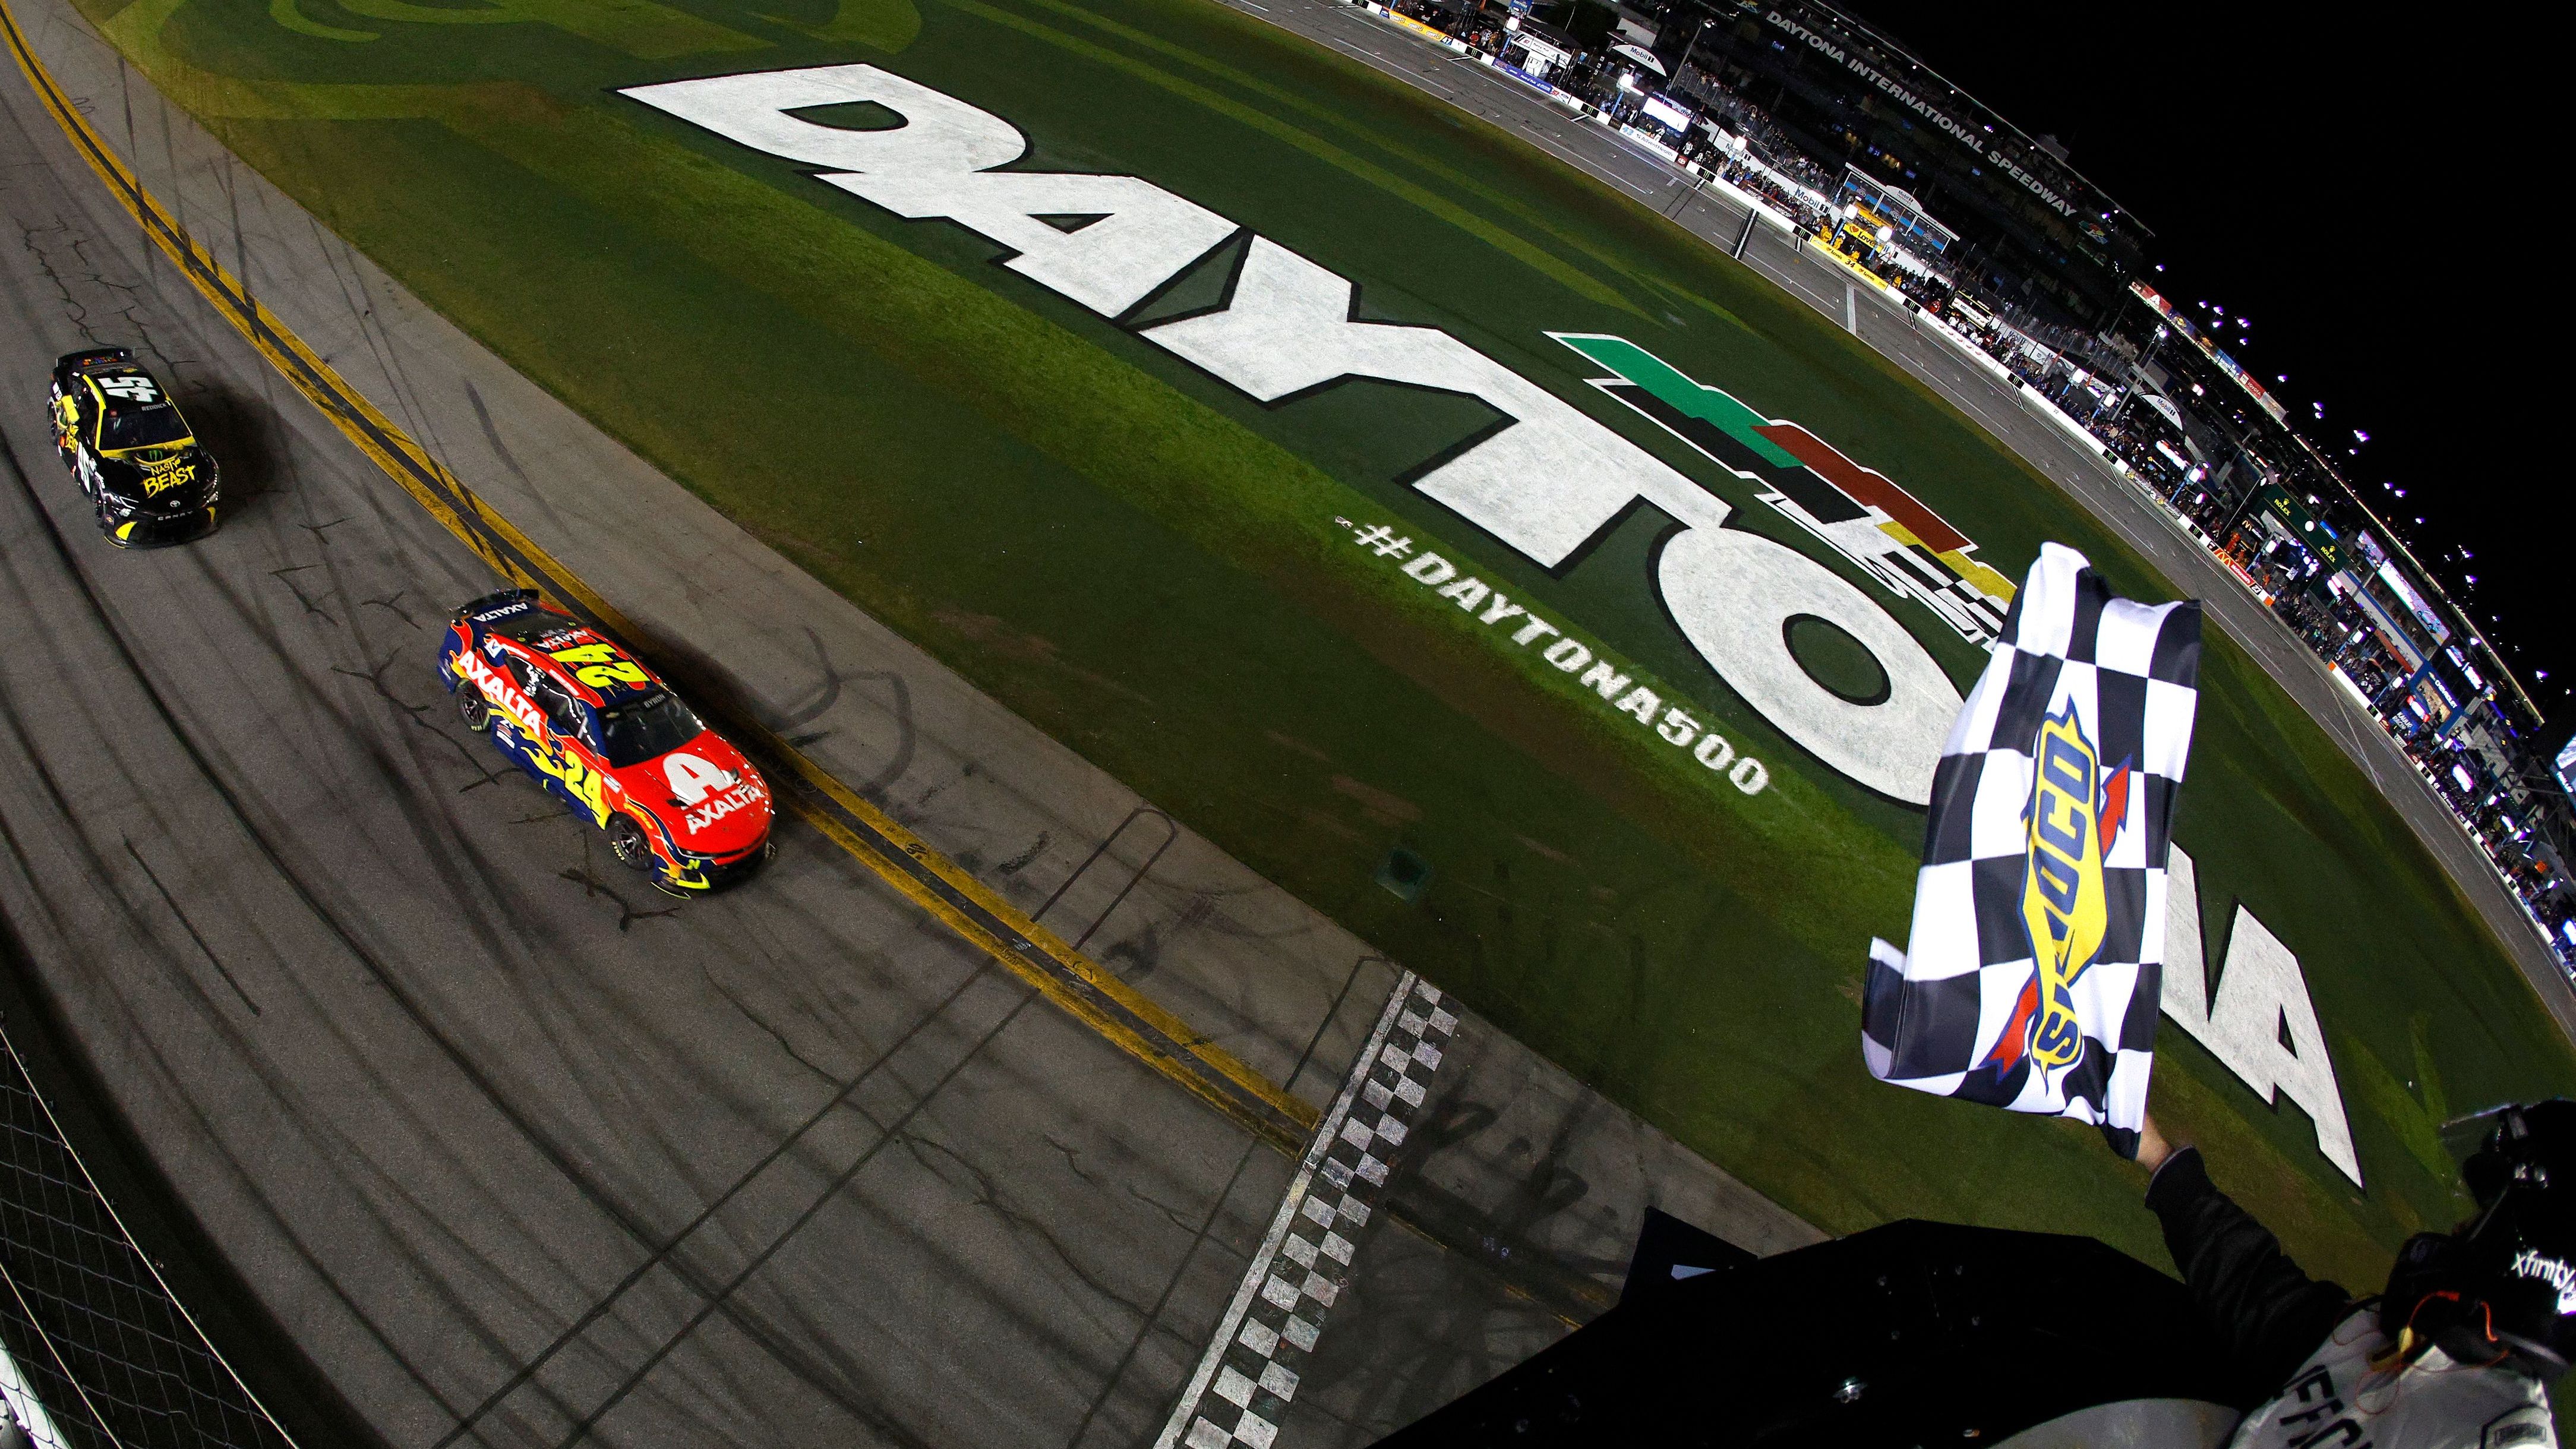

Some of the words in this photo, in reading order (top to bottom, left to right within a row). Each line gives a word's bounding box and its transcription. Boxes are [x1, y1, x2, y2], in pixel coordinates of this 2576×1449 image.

[1630, 47, 1648, 60] Mobil
[1766, 11, 1845, 63] DAYTONA
[1848, 58, 1984, 154] INTERNATIONAL
[1988, 151, 2077, 217] SPEEDWAY
[1622, 126, 1634, 136] 43
[1641, 134, 1674, 157] AdventHealth
[1745, 188, 1764, 201] NASCAR
[1795, 187, 1820, 207] Mobil
[1774, 206, 1793, 218] NASCAR
[1857, 231, 1876, 247] Love
[1845, 259, 1856, 268] 34
[97, 377, 158, 402] 45
[141, 403, 167, 412] REDDICK
[2157, 399, 2171, 412] Mobil
[150, 457, 181, 476] NASTY
[143, 465, 196, 499] BEAST
[2274, 498, 2291, 516] ROLEX
[2321, 546, 2336, 563] ROLEX
[2251, 585, 2262, 593] 23
[472, 602, 528, 623] AXALTA
[617, 62, 2363, 1188] DAYTOA
[548, 643, 651, 688] 24
[1355, 525, 1770, 795] #DAYTONA500
[458, 649, 541, 738] AXALTA
[643, 693, 666, 709] BYRON
[2435, 680, 2458, 708] CHEVROLET
[2392, 715, 2407, 730] RACIN
[564, 750, 602, 819] 24
[684, 784, 765, 835] AXALTA
